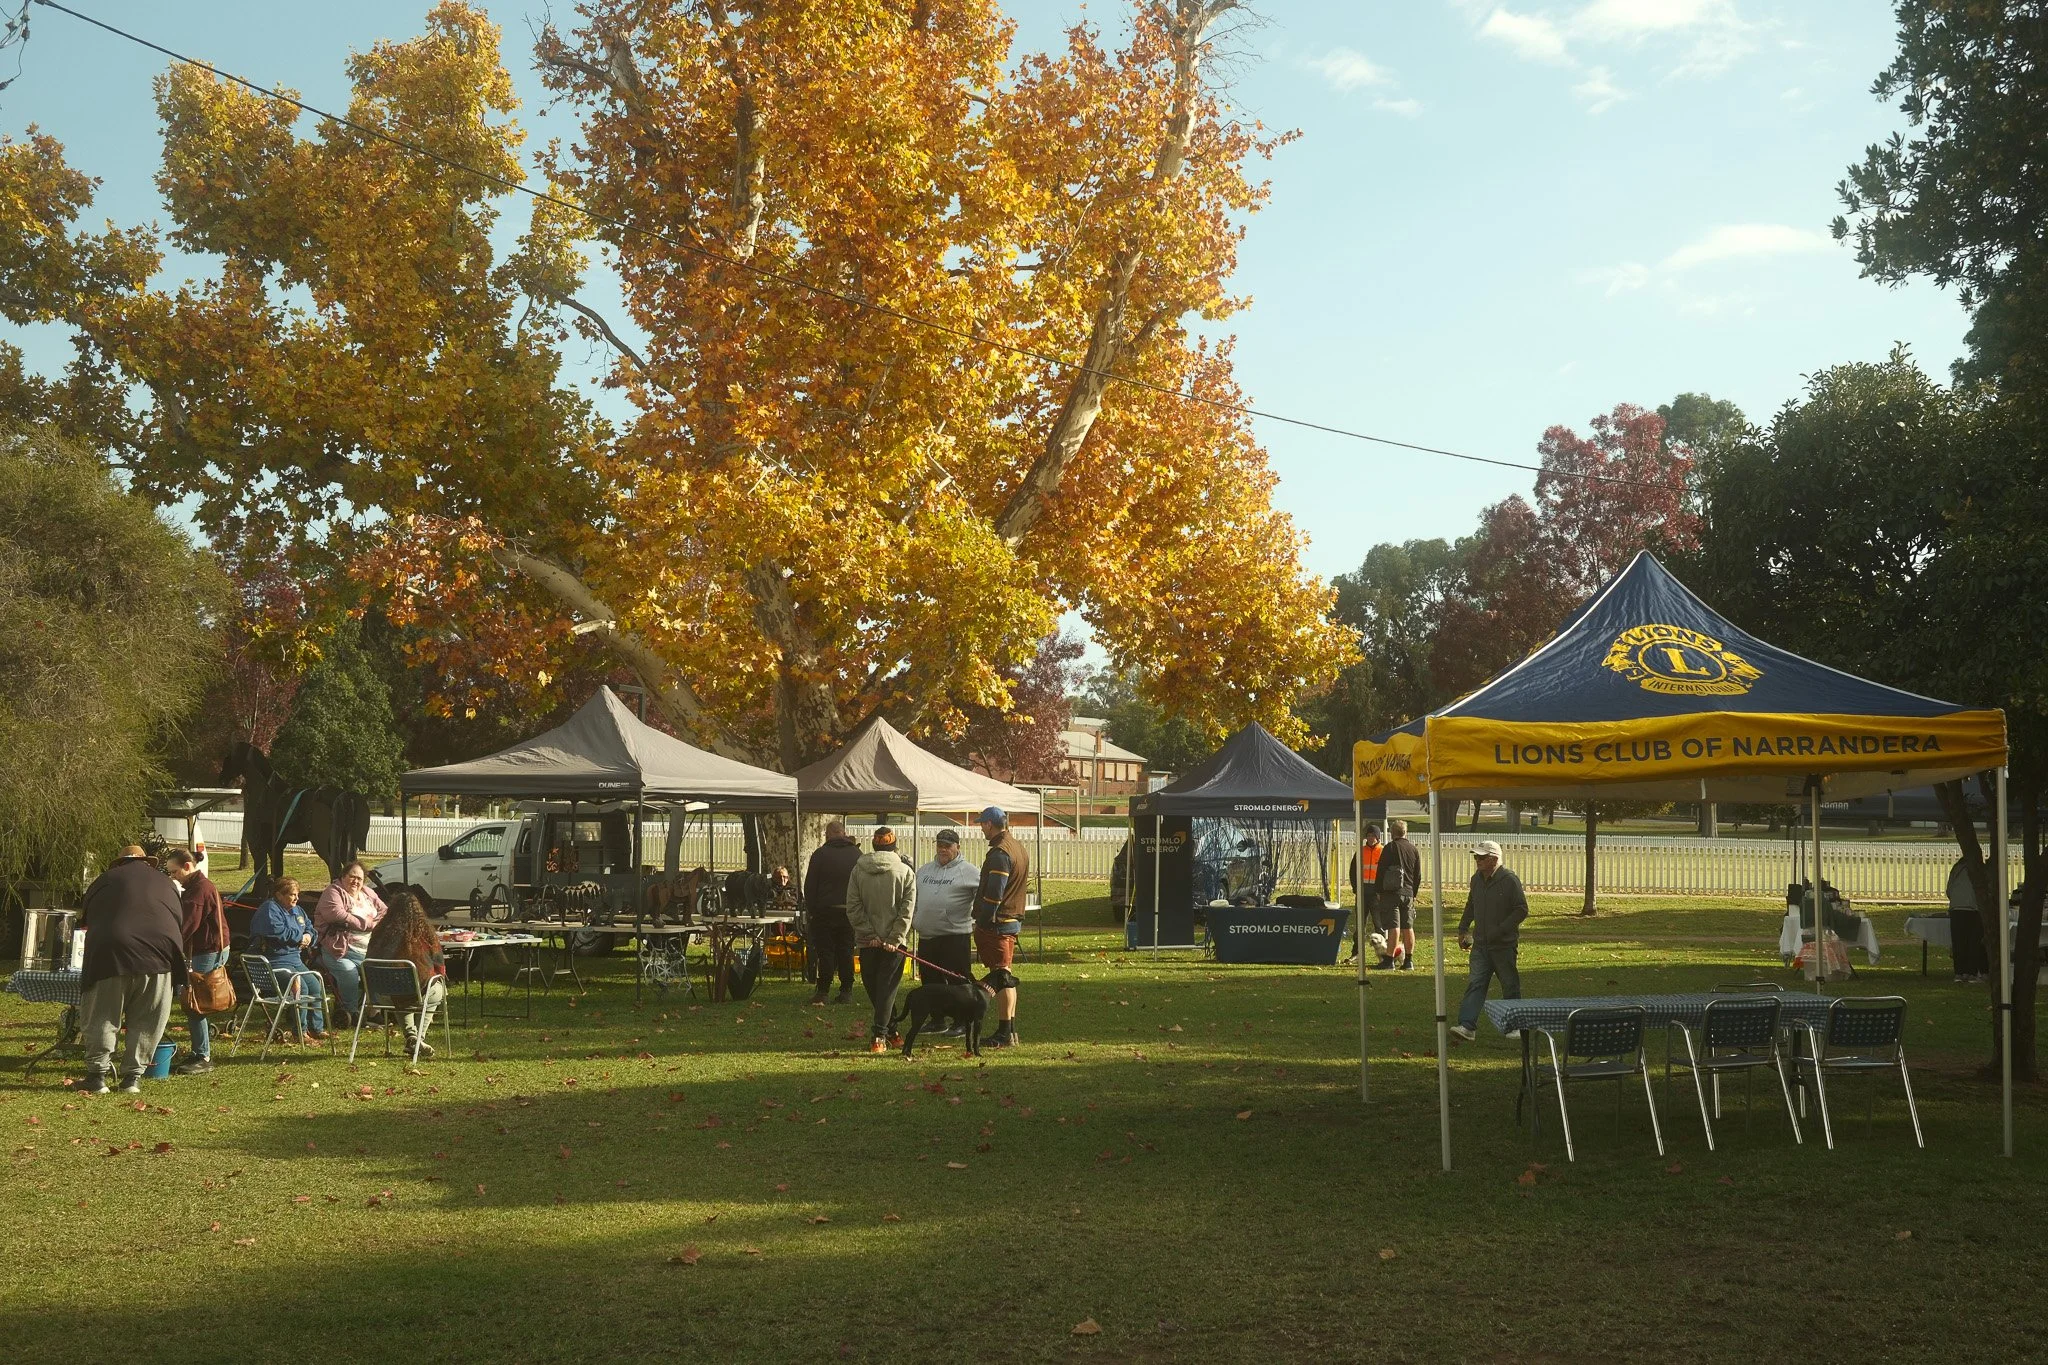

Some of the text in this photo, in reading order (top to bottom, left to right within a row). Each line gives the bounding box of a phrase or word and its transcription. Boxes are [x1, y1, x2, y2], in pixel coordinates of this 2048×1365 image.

[1626, 626, 1717, 650] LIONS
[1661, 647, 1711, 676] L
[1648, 680, 1742, 695] INTERNATIONAL
[1495, 734, 1941, 764] LIONS CLUB OF NARRANDERA
[1271, 804, 1303, 812] ENERGY
[1229, 924, 1327, 935] STROMLO ENERGY
